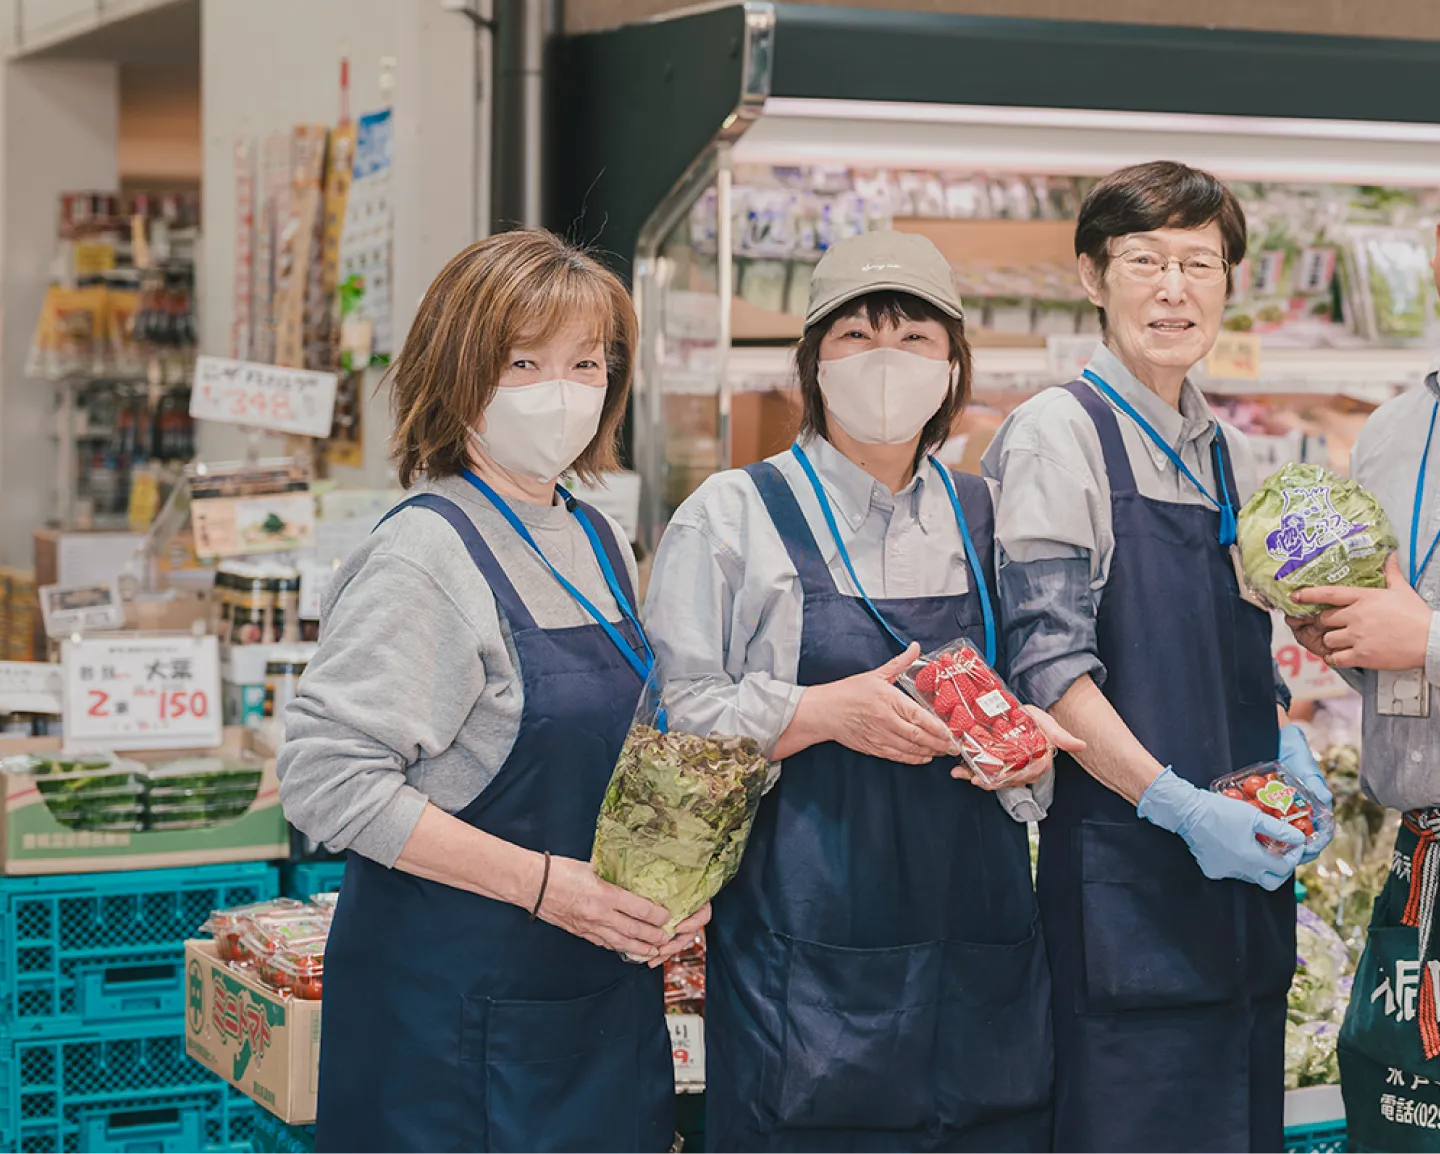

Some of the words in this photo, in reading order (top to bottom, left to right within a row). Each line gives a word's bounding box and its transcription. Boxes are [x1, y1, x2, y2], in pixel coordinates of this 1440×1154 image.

[145, 658, 193, 681] 大葉
[88, 690, 109, 717] 2
[159, 689, 207, 720] 150
[213, 977, 271, 1058] ミニトマト
